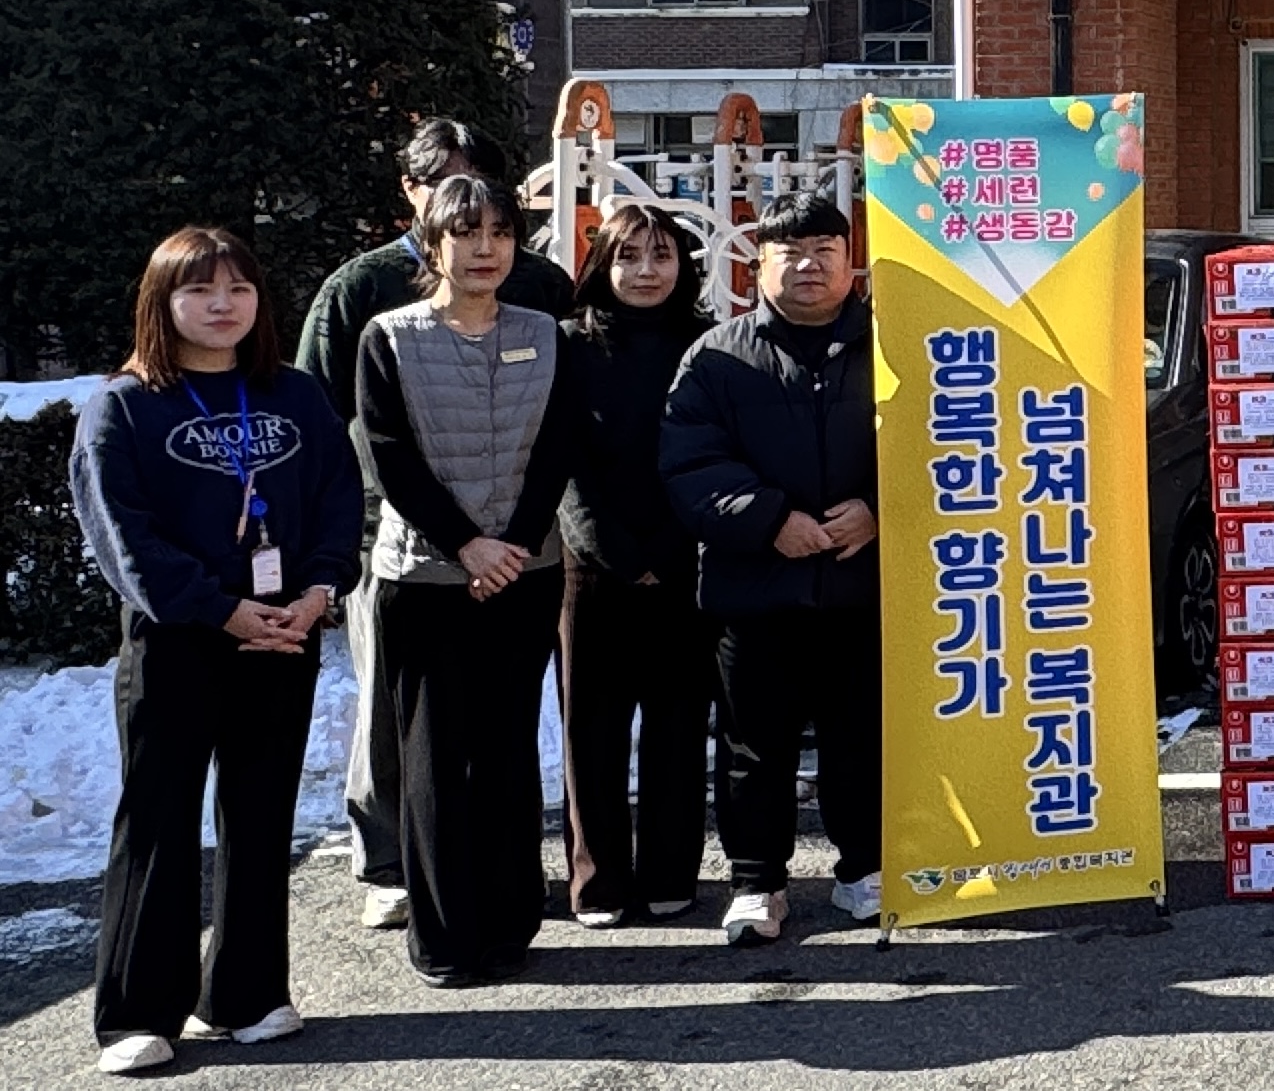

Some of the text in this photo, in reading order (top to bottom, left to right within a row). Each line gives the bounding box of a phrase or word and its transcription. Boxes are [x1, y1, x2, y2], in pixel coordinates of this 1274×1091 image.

[941, 141, 1038, 170] #명품
[942, 176, 1039, 205] #세련
[943, 210, 1075, 242] #생동감
[184, 418, 287, 445] AMOUR
[928, 329, 1006, 715] 행복한 향기가
[1020, 386, 1098, 833] 넘쳐나는 복지관
